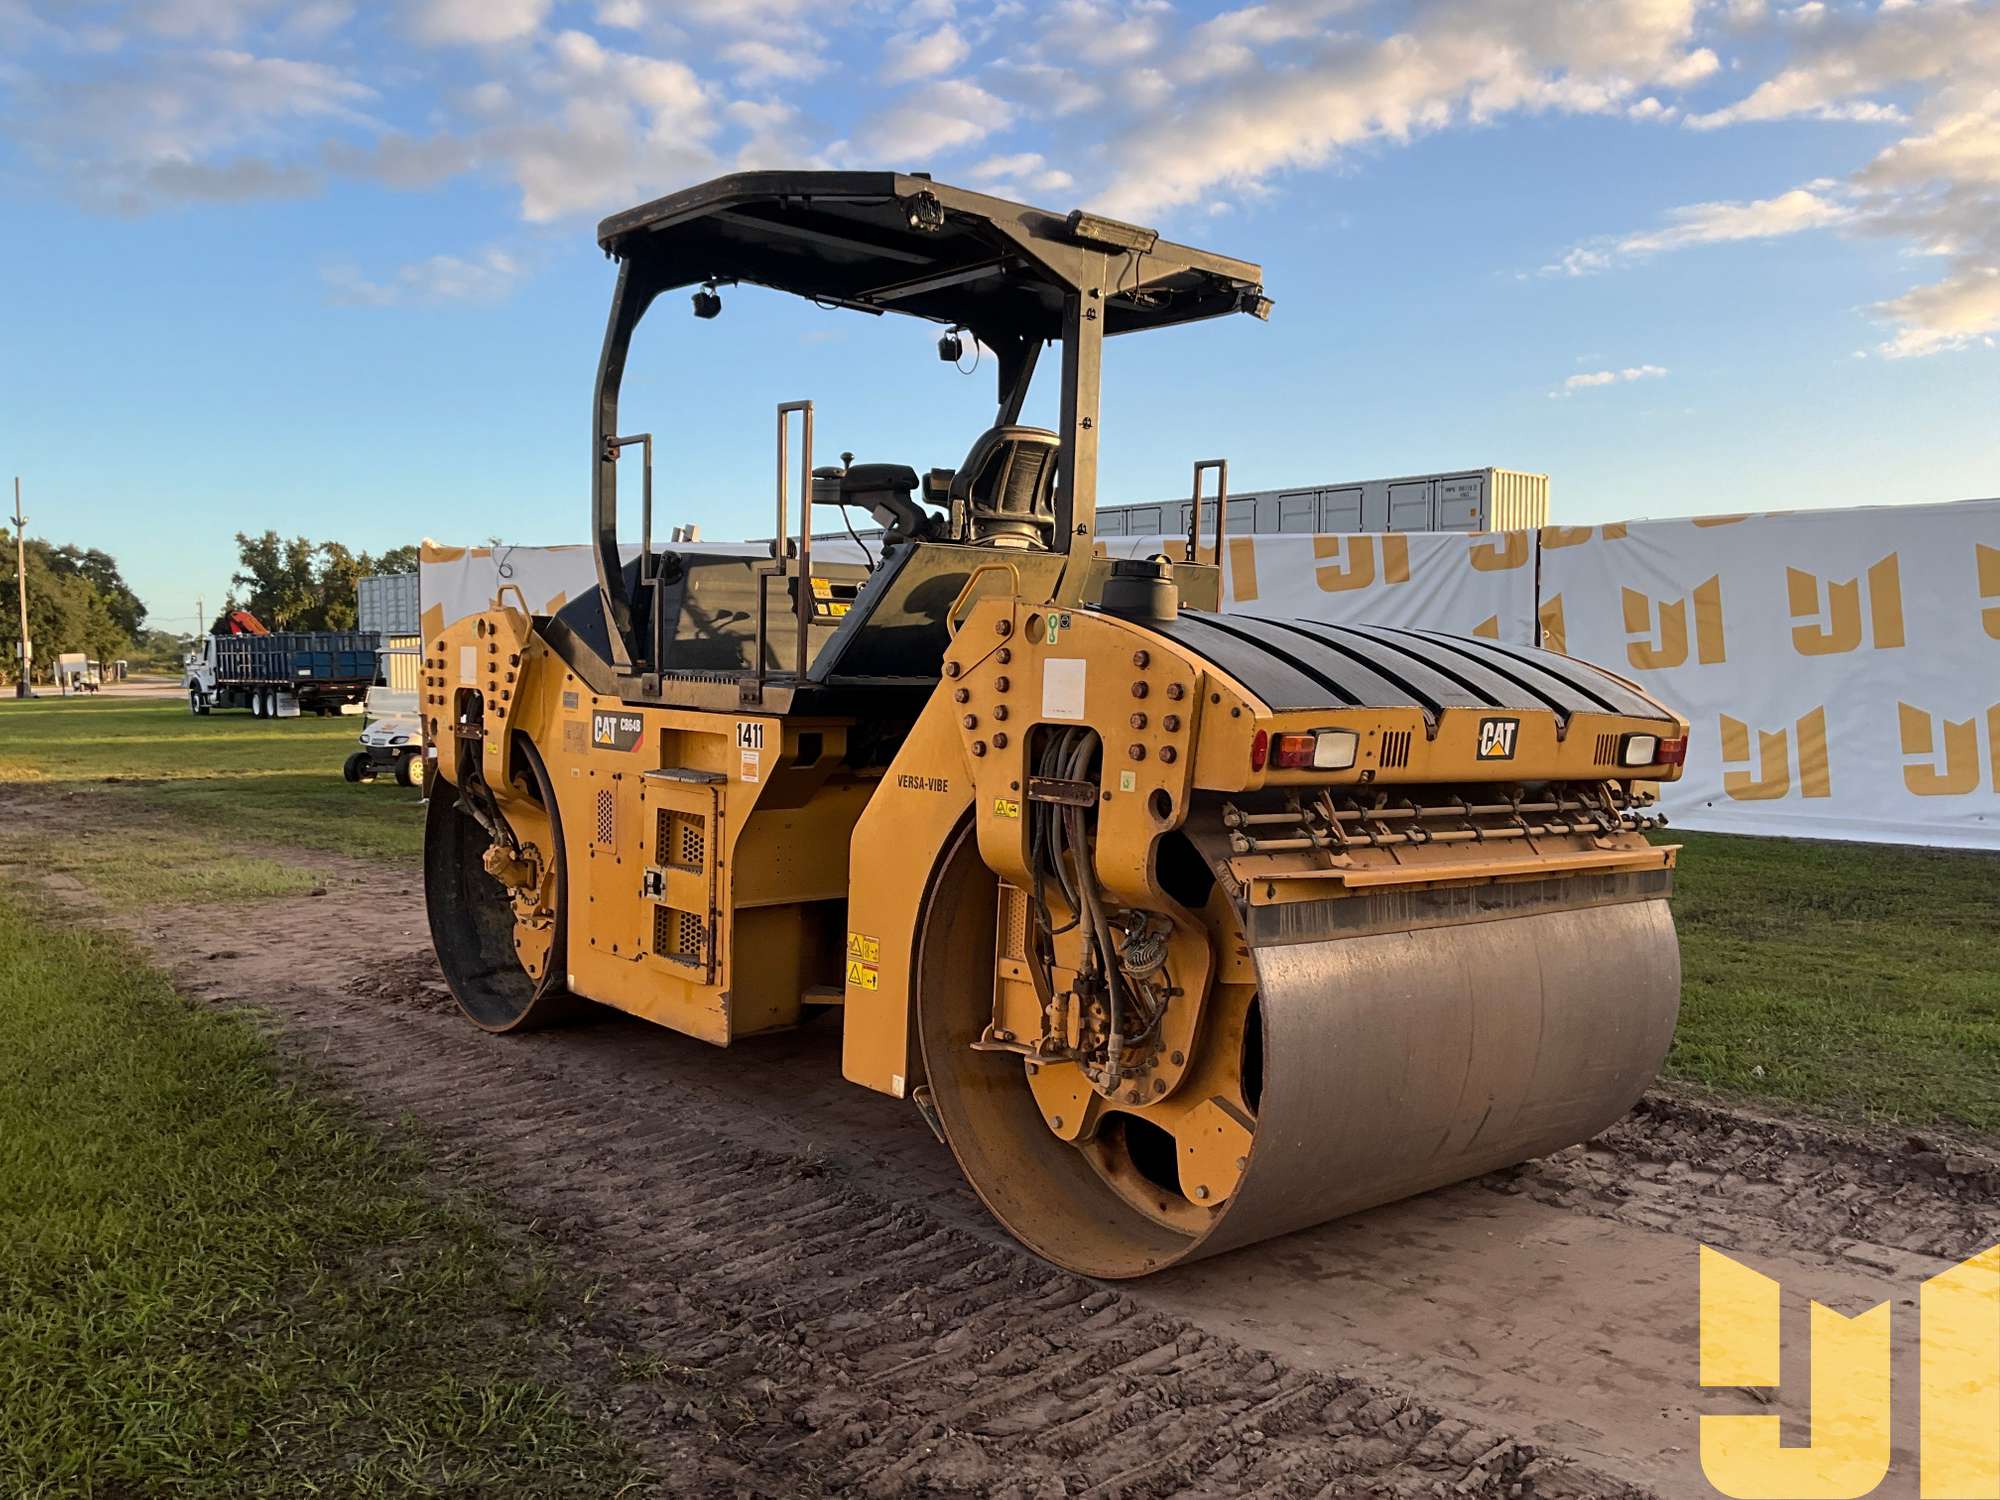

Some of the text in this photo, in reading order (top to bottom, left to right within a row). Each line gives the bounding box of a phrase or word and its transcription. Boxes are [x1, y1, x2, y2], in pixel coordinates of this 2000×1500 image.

[594, 715, 617, 745] CAT
[736, 722, 764, 749] 1411
[1480, 722, 1516, 756] CAT
[897, 774, 949, 793] VERSA-VIBE
